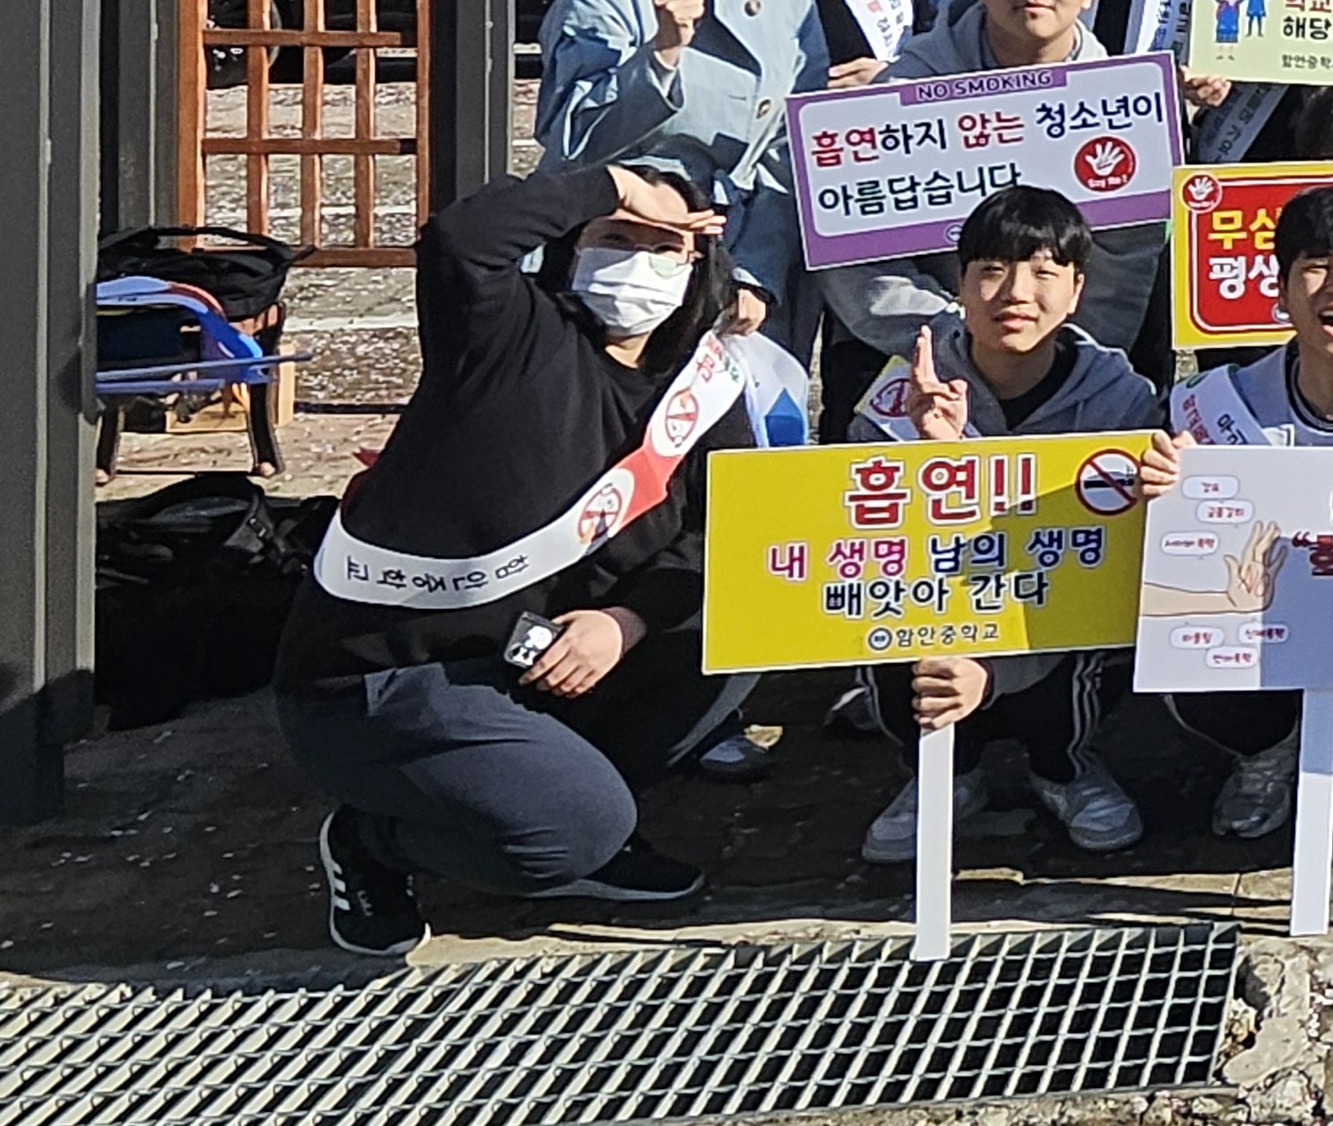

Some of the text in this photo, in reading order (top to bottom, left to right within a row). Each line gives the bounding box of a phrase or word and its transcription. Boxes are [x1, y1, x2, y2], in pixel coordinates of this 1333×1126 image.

[917, 70, 1053, 101] NO SMOKING
[811, 118, 948, 167] 흡연하지
[957, 110, 1025, 150] 않는
[1034, 91, 1164, 138] 청소년이
[817, 162, 1022, 217] 아름답습니다
[1208, 206, 1279, 250] 무심
[848, 455, 1036, 529] 흡연!!
[346, 554, 528, 594] 함안중학교
[770, 526, 1104, 580] 내 생명 남의 생명
[824, 571, 1050, 617] 빼앗아 간다
[895, 623, 1000, 650] 함안중학교
